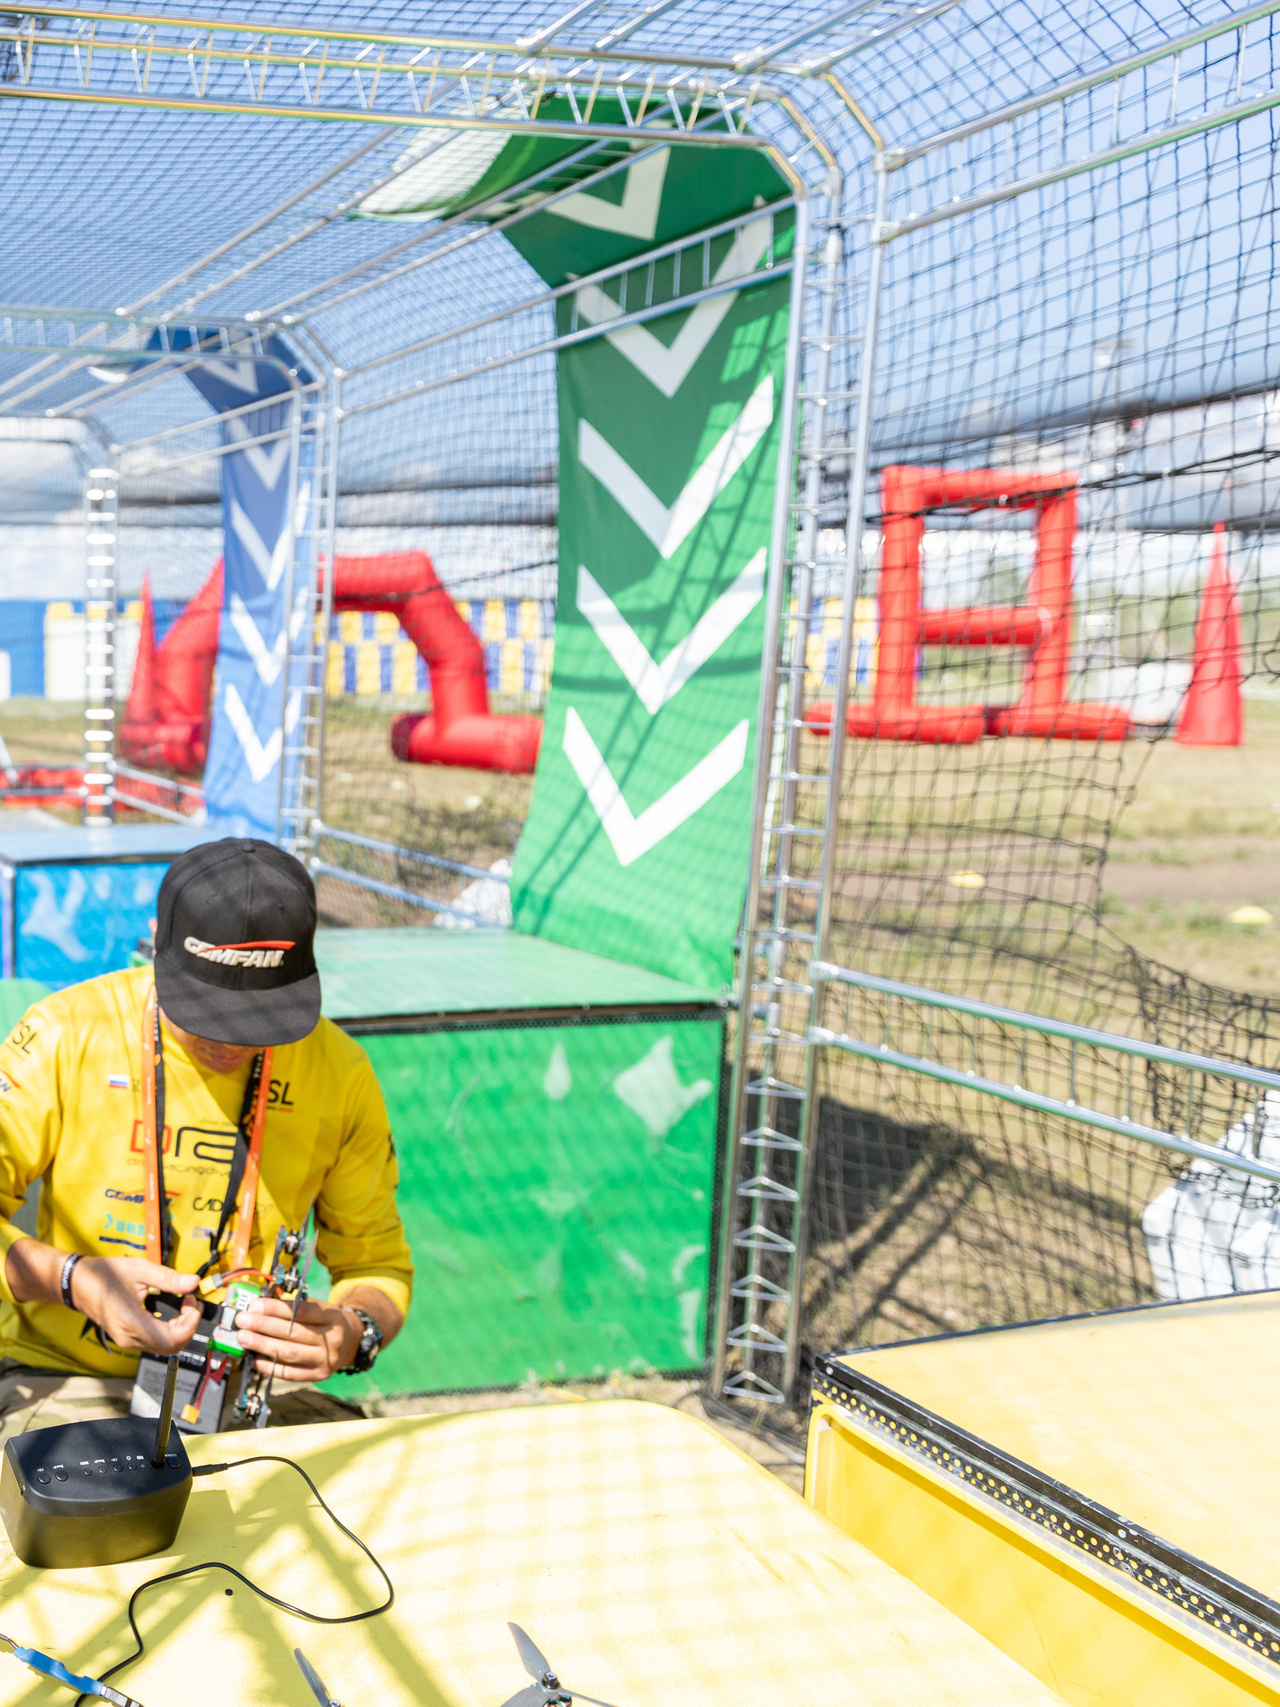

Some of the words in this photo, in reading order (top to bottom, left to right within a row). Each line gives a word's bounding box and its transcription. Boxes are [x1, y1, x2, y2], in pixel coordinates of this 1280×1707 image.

[184, 936, 286, 968] GEMFAN
[12, 1025, 38, 1054] SL
[268, 1079, 294, 1106] SL
